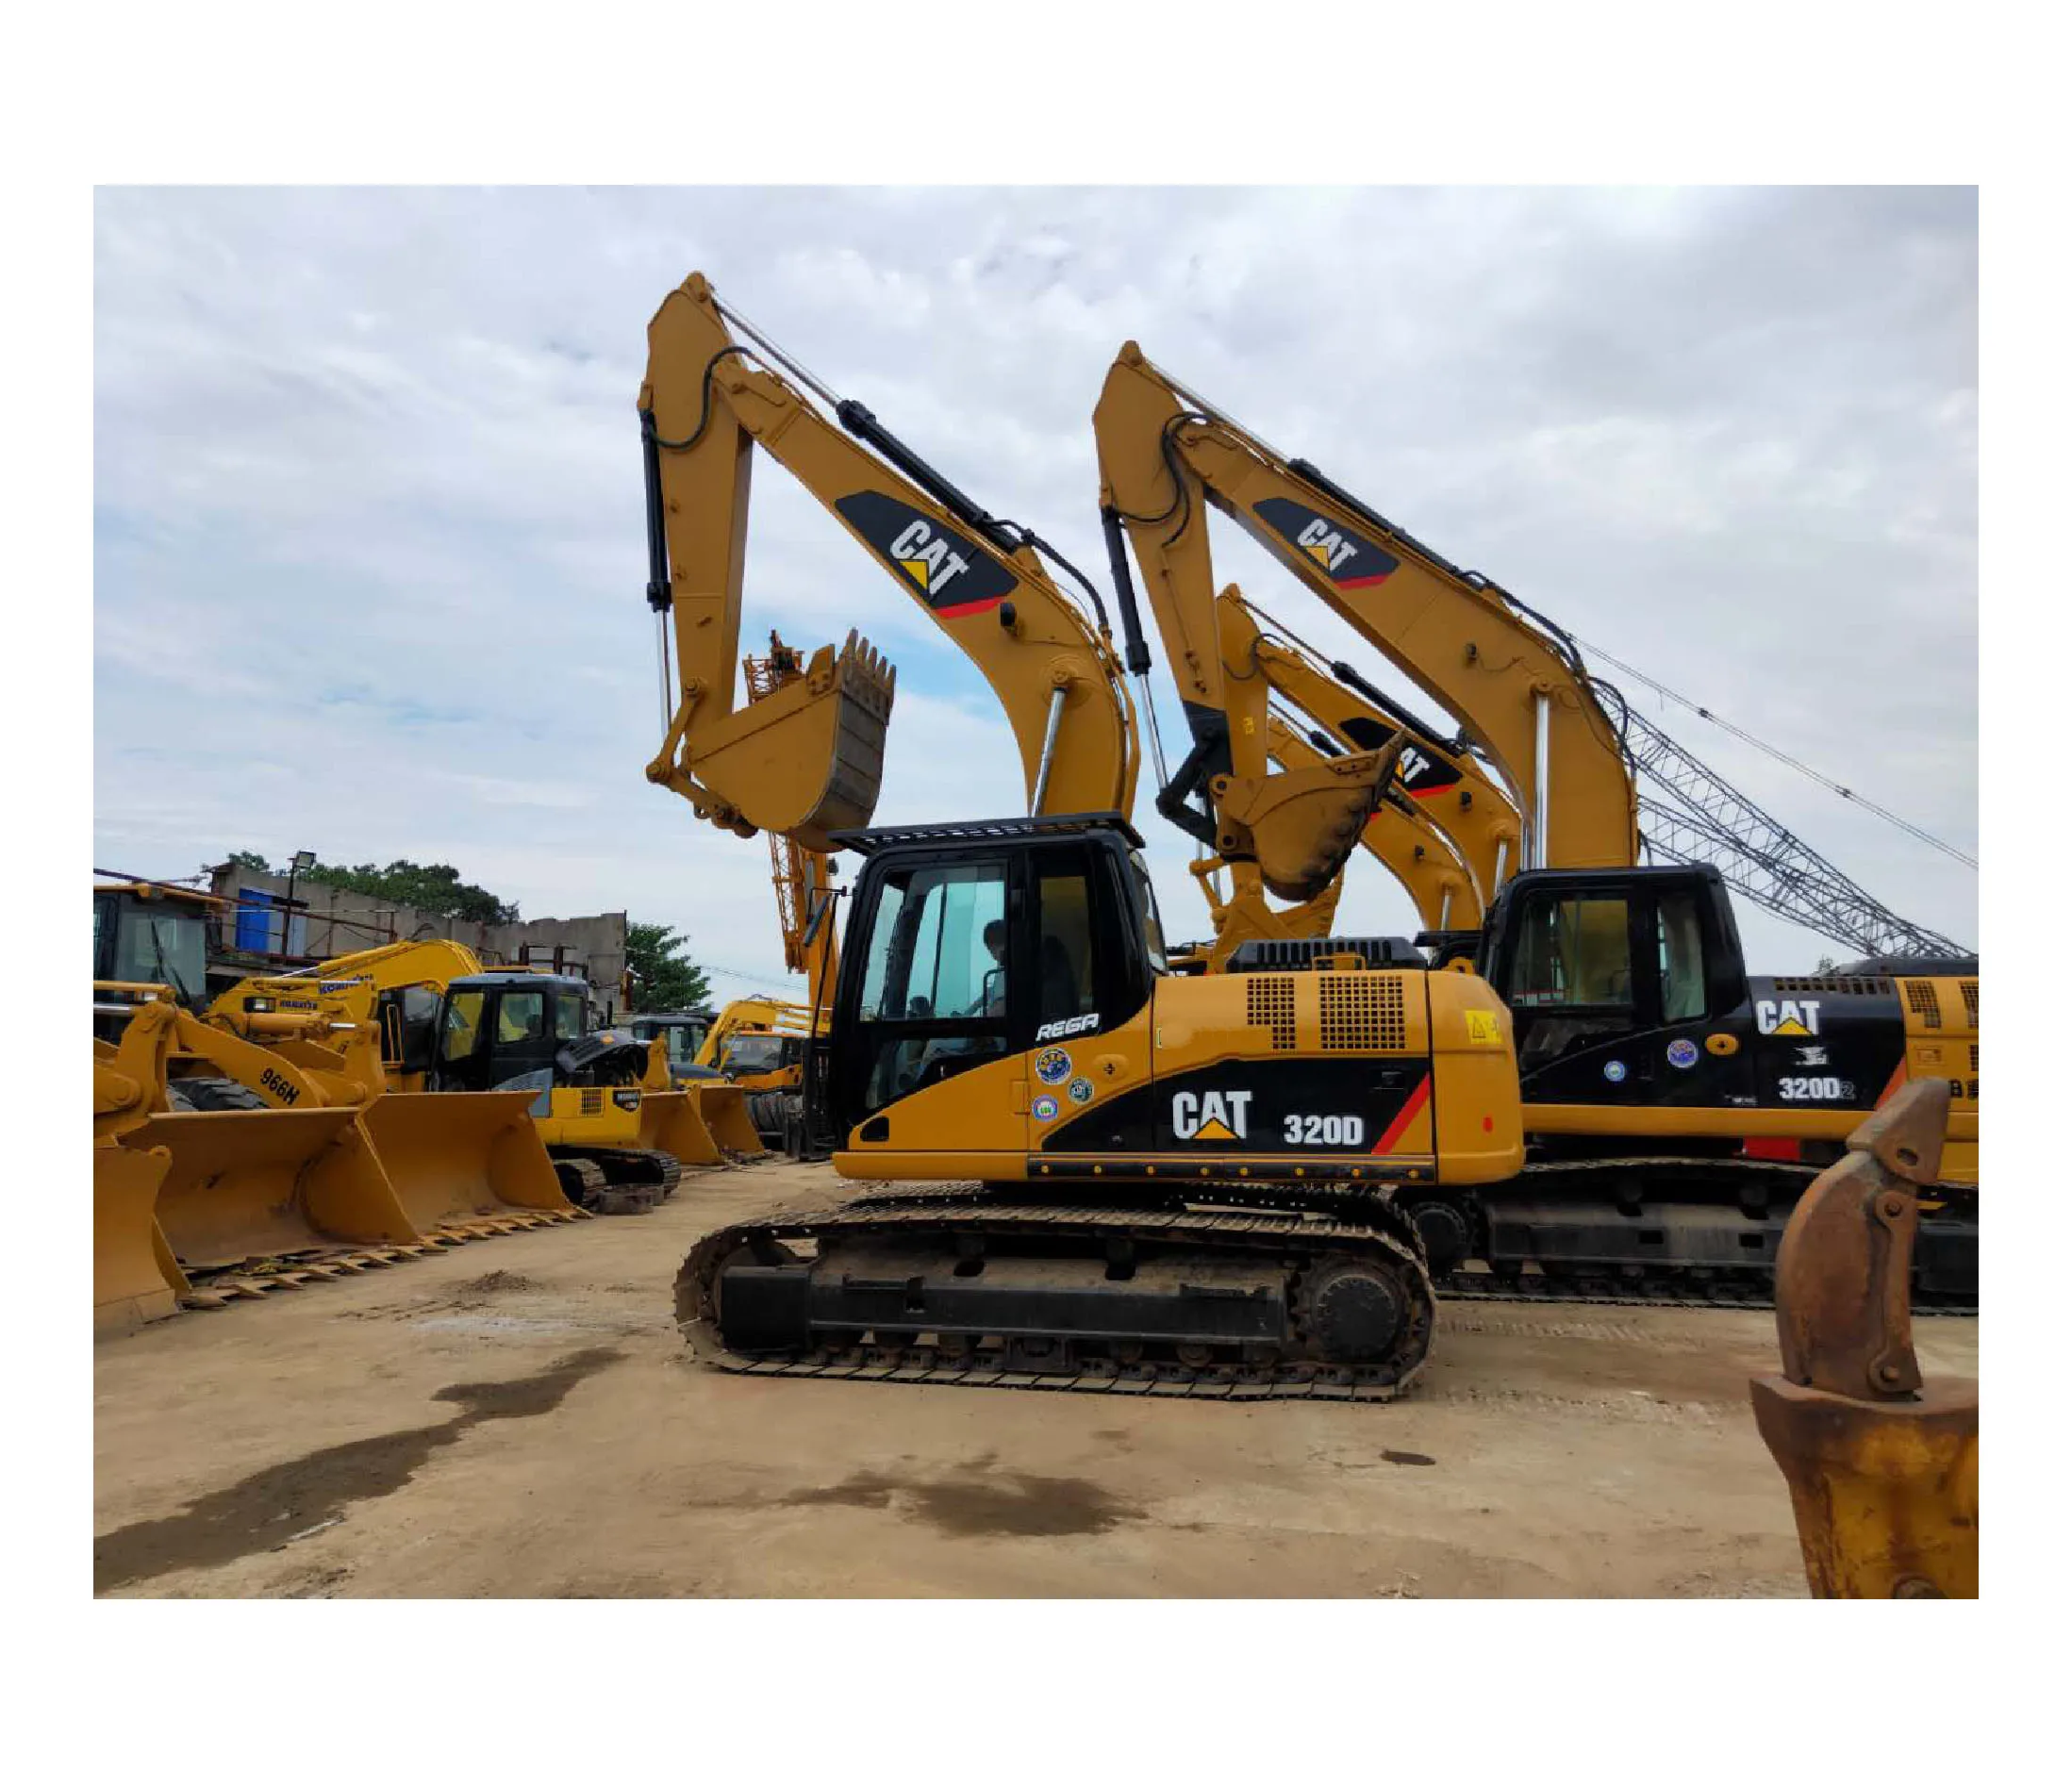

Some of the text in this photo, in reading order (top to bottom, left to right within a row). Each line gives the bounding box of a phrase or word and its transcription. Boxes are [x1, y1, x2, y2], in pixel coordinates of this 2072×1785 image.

[890, 520, 970, 594] CAT
[1298, 519, 1357, 571] CAT
[1401, 747, 1431, 783] AT
[1036, 1013, 1100, 1042] REGA
[1756, 1000, 1820, 1035] CAT
[259, 1067, 300, 1105] 966H
[1172, 1090, 1364, 1145] CAT 320D
